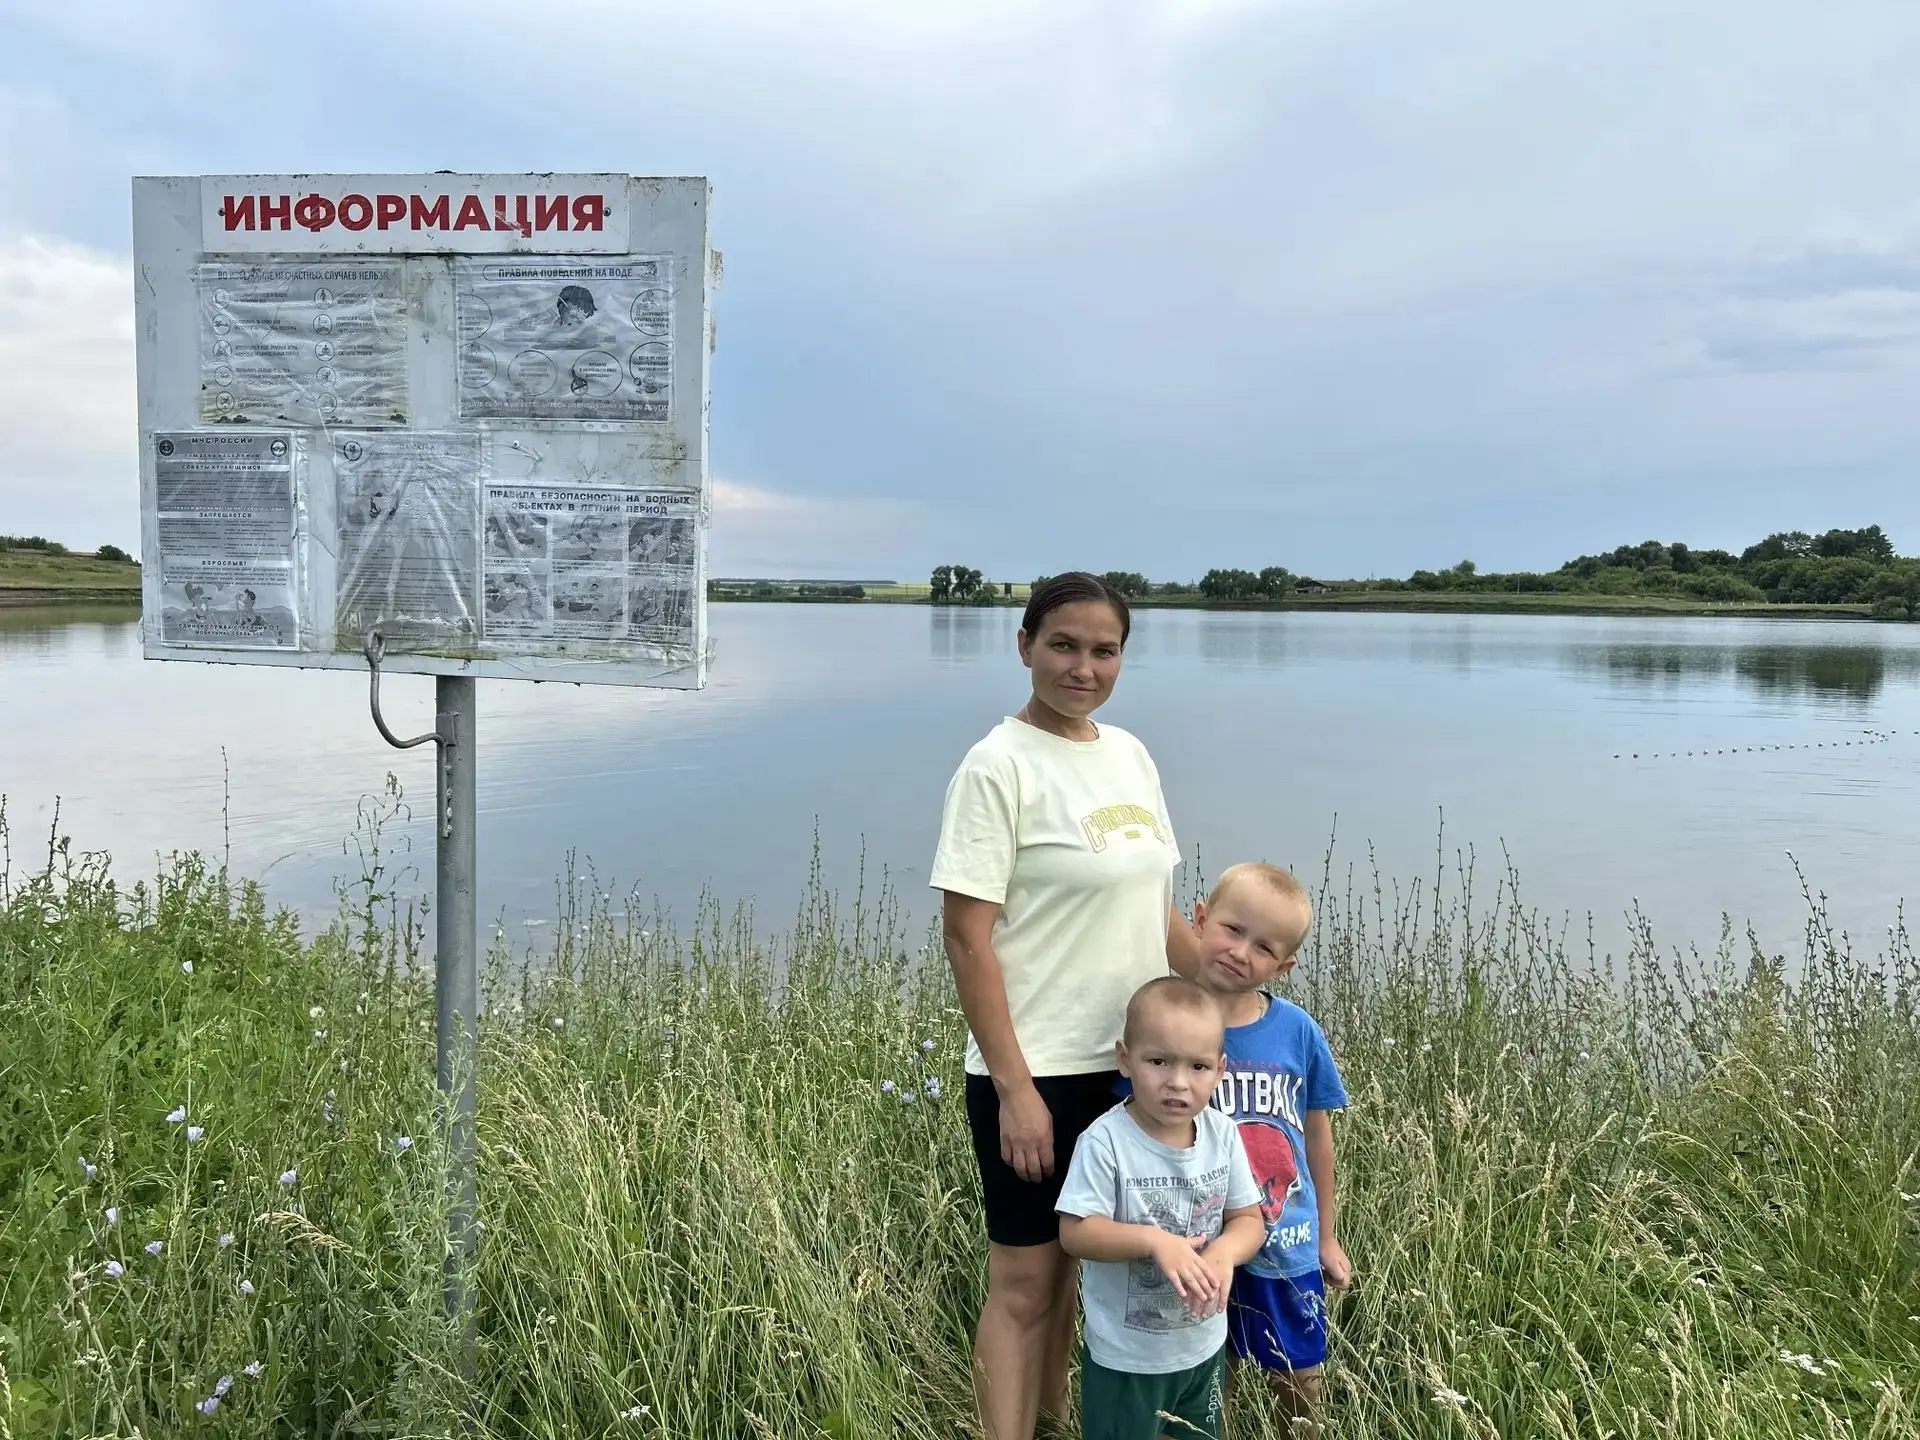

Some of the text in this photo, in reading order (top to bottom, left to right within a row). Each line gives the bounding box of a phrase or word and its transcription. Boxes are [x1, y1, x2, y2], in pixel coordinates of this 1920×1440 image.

[223, 193, 604, 238] ИНФОРМАЦИЯ
[217, 271, 228, 280] ВО
[324, 271, 357, 281] СЛУЧАЕВ
[498, 268, 633, 279] ПРАВИЛА ПОВЕДЕНИЯ НА ВОДЕ
[489, 490, 690, 505] ПРАВИЛА БЕЗОПАСНОСТИ НА ВОДНЫХ
[568, 503, 575, 511] В
[625, 505, 668, 515] ПЕРИОД
[1126, 1176, 1169, 1188] MONSTER
[1170, 1176, 1200, 1188] TRUCK
[1280, 1220, 1312, 1250] FAME
